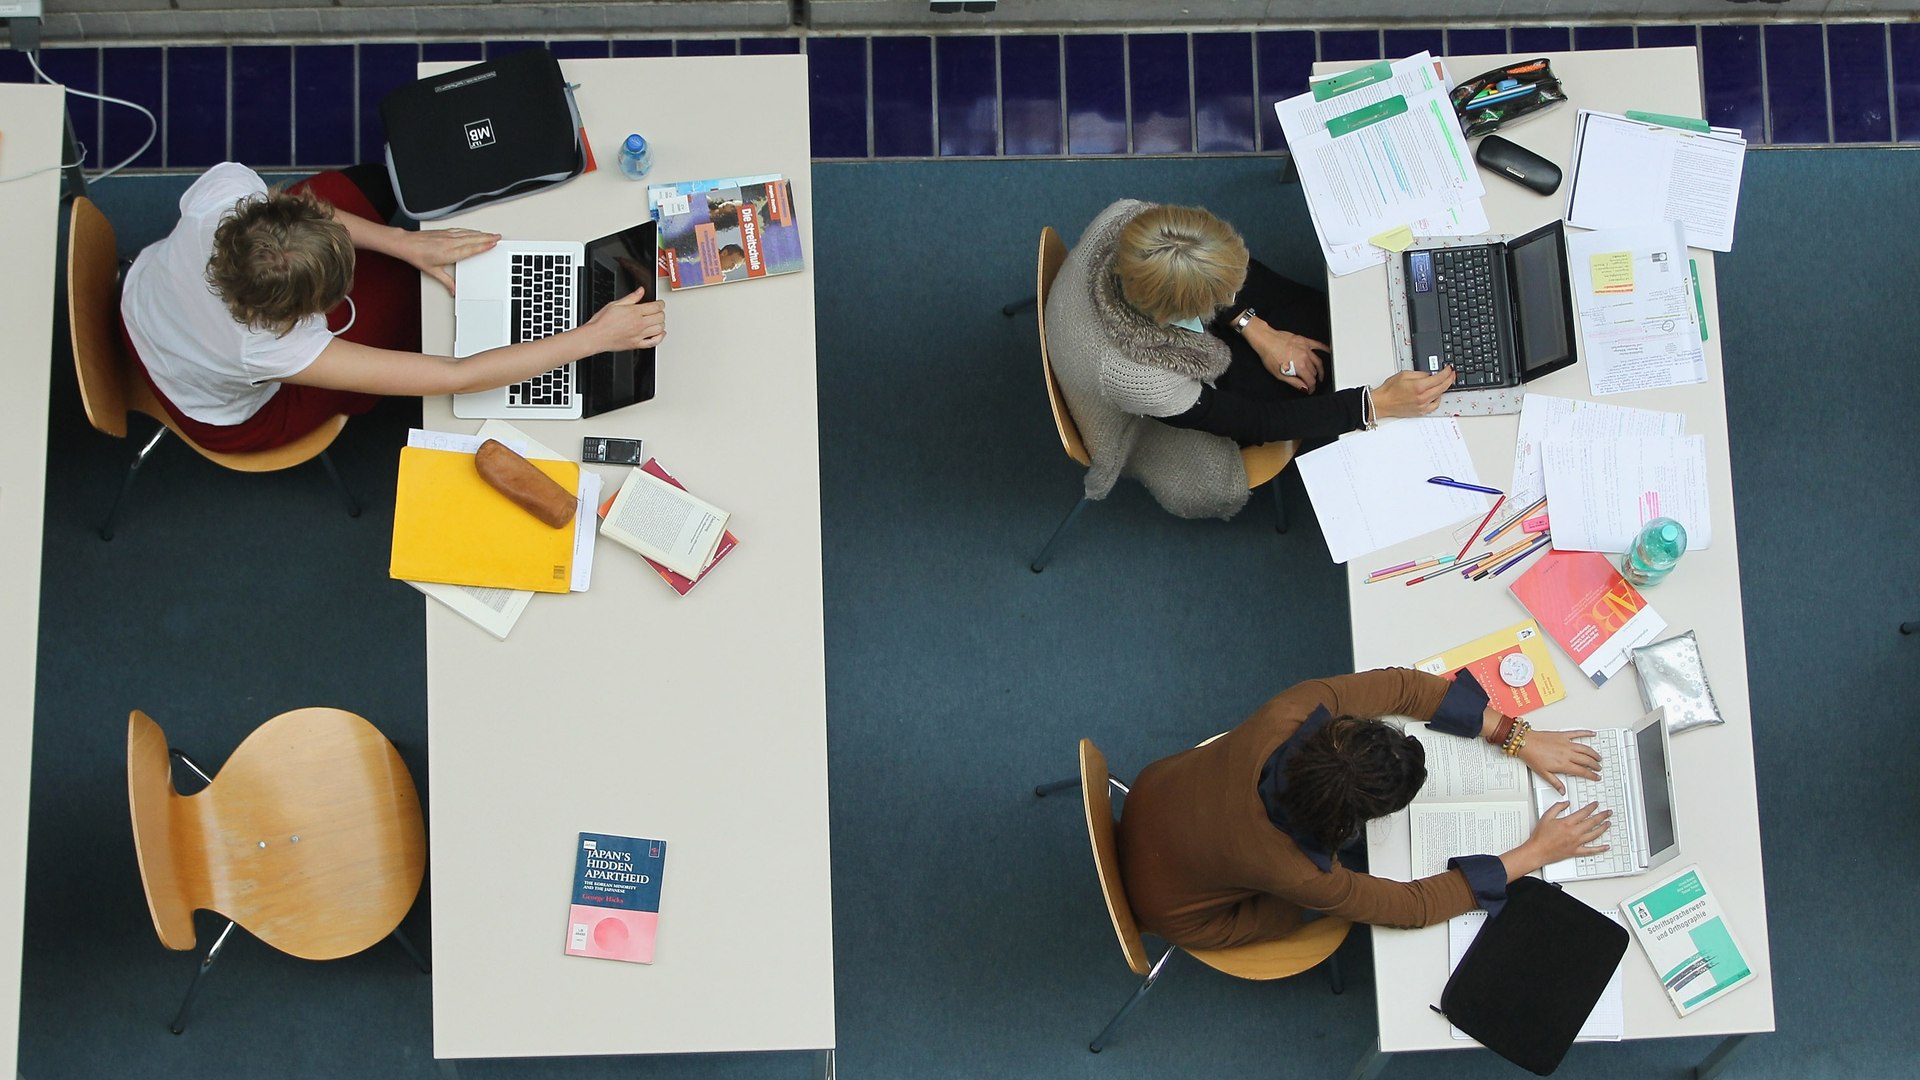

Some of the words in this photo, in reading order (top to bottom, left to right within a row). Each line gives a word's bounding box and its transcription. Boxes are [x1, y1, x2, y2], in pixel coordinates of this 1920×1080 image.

[469, 126, 490, 141] MB
[741, 208, 752, 222] Die
[744, 222, 760, 271] Streitschule
[588, 849, 631, 861] JAPAN'S
[586, 858, 634, 872] HIDDEN
[585, 869, 650, 884] APARTHEID
[606, 895, 624, 903] Hicks
[1647, 900, 1706, 934] Schriftspracherwerb
[1656, 931, 1669, 941] und
[1668, 911, 1707, 935] Orthographie
